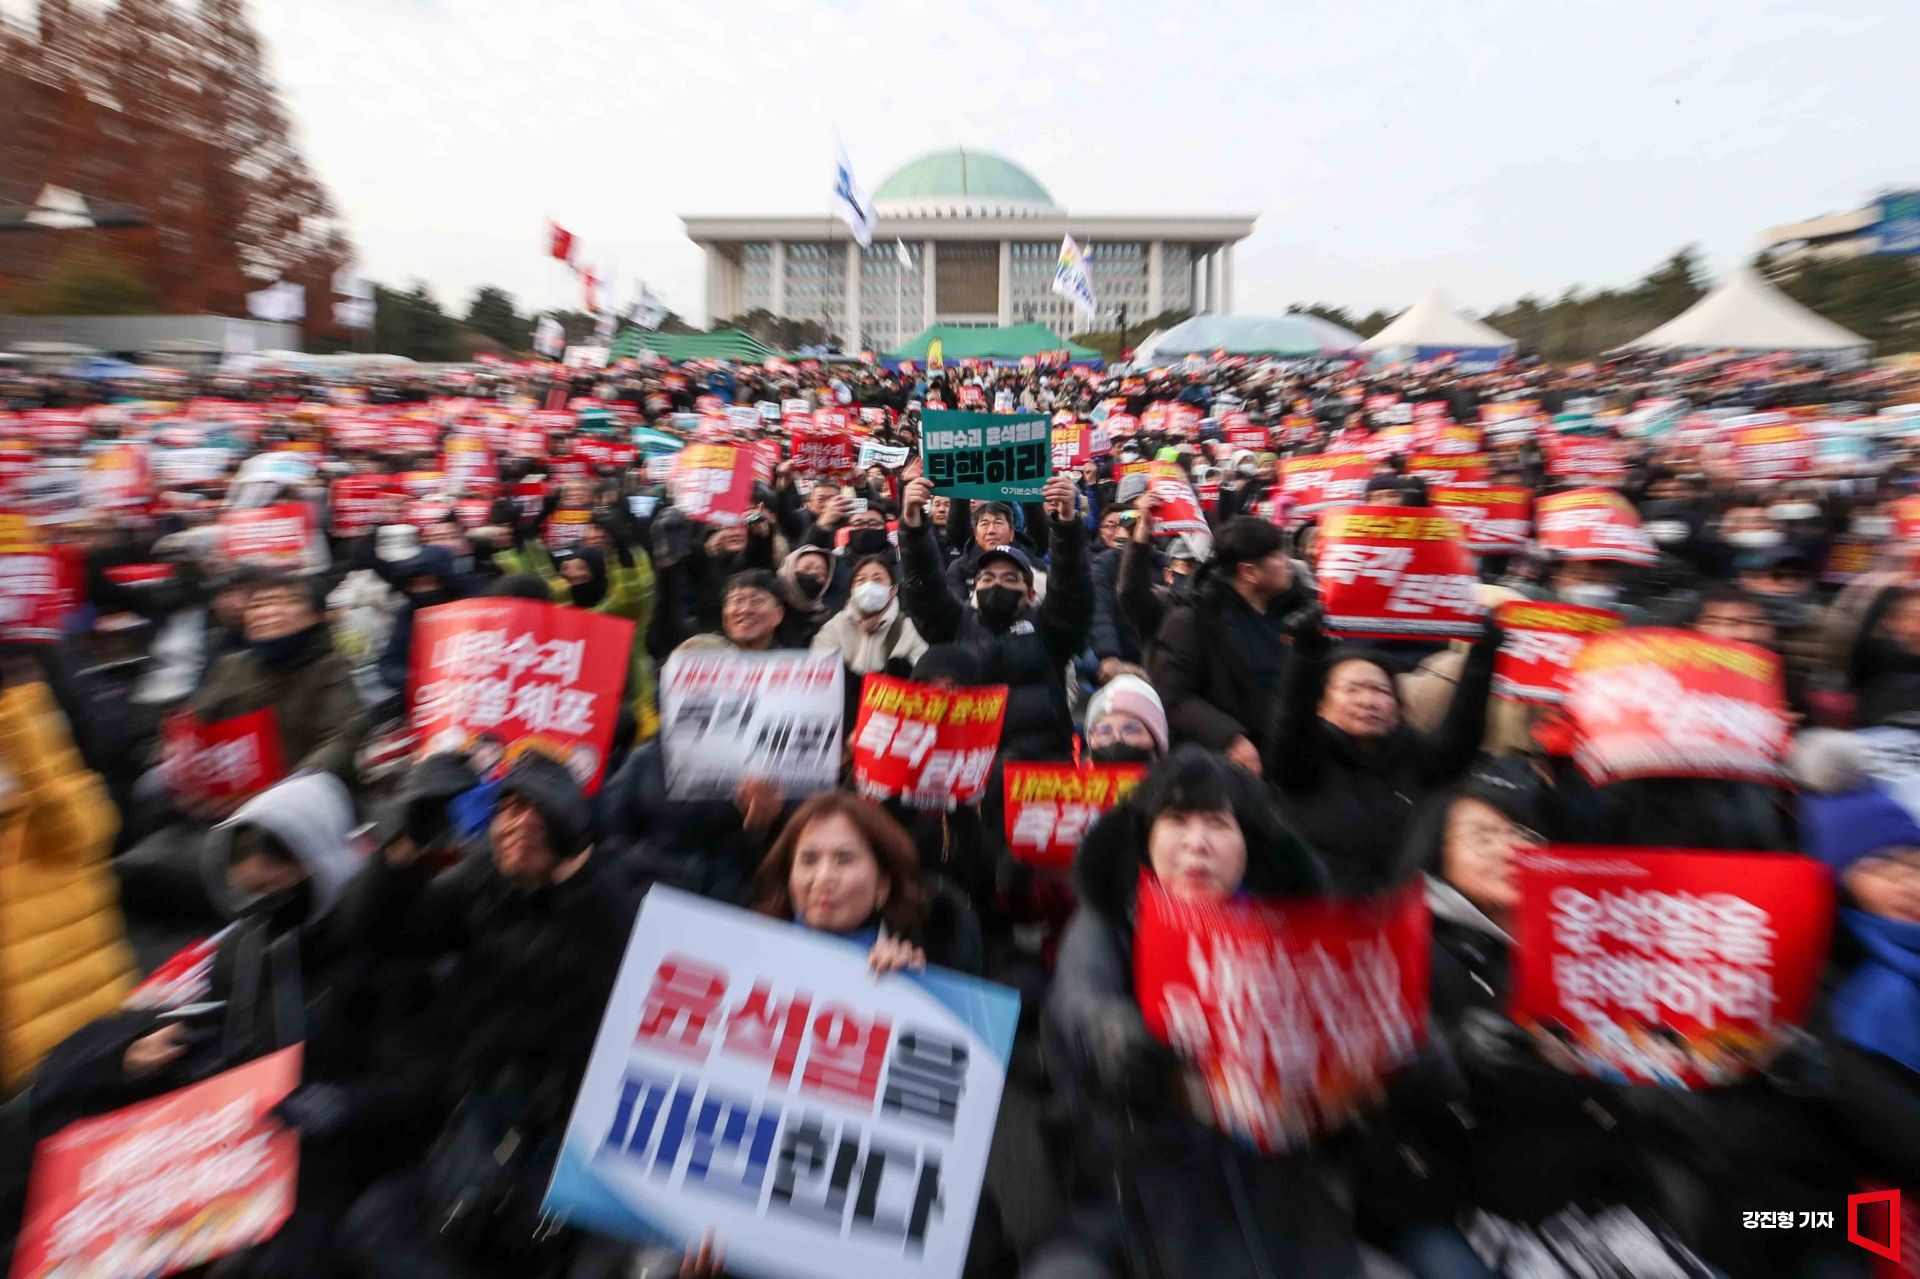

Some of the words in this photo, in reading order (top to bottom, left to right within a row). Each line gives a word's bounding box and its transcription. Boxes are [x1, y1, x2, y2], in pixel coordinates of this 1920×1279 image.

[926, 428, 982, 450] 내란수괴
[996, 420, 1046, 446] 윤석열을
[928, 443, 1047, 488] 탄핵하라
[1317, 543, 1415, 586] 즉각
[865, 681, 950, 724] 내란수괴
[856, 711, 938, 769] 즉각
[915, 746, 998, 794] 탄핵
[1548, 886, 1777, 968] 윤석열을
[1550, 950, 1780, 1032] 탄핵하라
[634, 952, 970, 1138] 윤석열을
[599, 1066, 944, 1259] 파면한다
